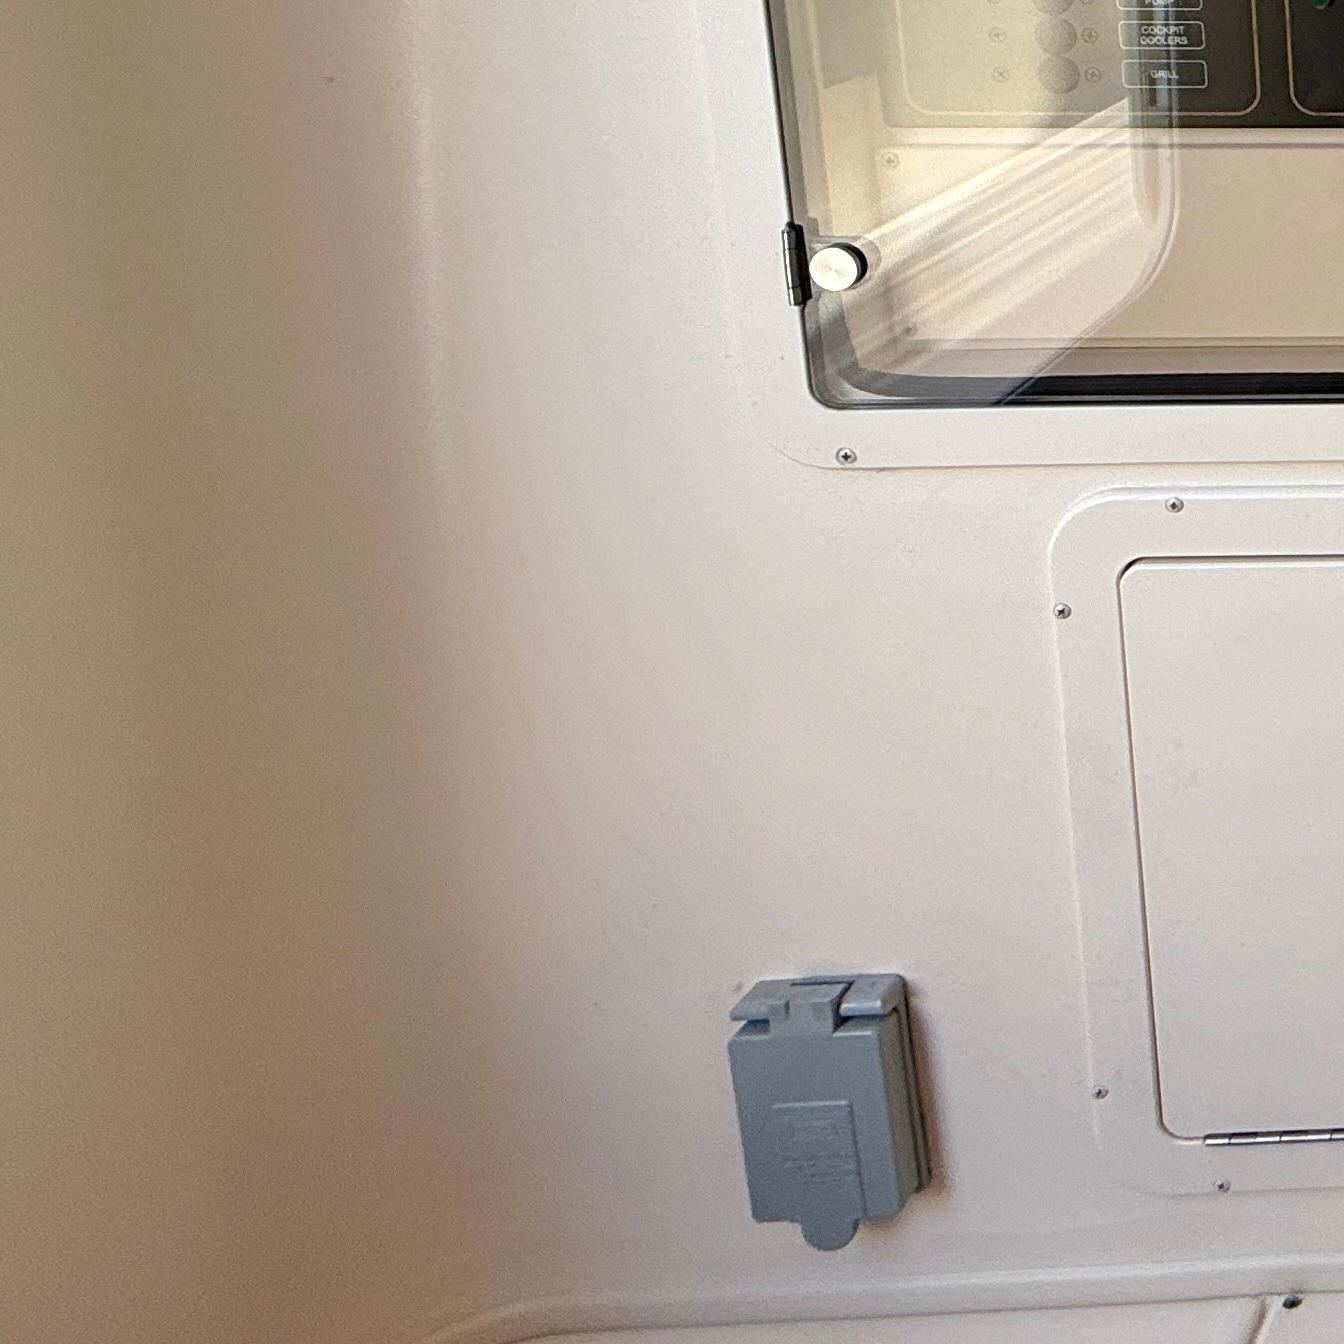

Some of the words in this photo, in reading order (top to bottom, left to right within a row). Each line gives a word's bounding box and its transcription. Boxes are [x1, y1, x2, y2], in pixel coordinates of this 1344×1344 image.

[1141, 25, 1185, 35] COCKPIT
[1140, 35, 1188, 45] COOLERS
[1150, 69, 1179, 79] GRILL
